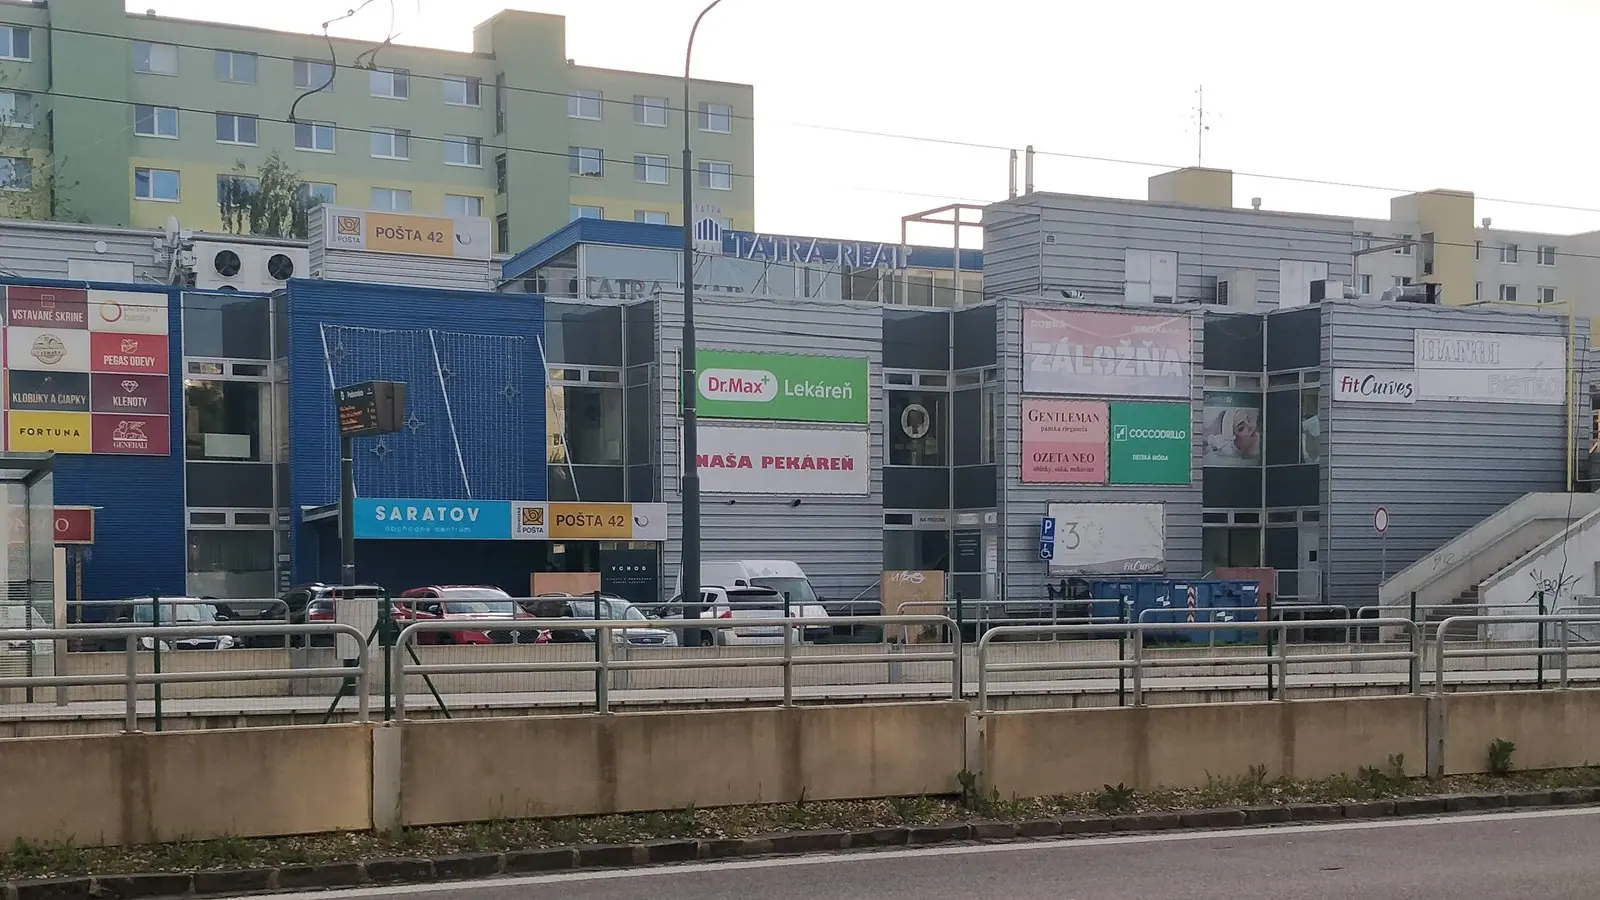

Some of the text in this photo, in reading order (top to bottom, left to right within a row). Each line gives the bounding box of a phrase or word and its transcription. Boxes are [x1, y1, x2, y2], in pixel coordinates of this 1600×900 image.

[338, 235, 360, 244] POŠTA
[376, 225, 443, 243] POŠTA 42
[731, 232, 825, 263] TATRA
[55, 311, 84, 323] SKRINE
[103, 355, 156, 367] PEGAS ODEVY
[1030, 336, 1183, 377] ZÁLOŽŇA
[784, 379, 852, 400] Lekáreň
[113, 396, 148, 407] KLENOTY
[19, 427, 80, 436] FORTUNA
[1129, 428, 1186, 439] COCCODRILLO
[113, 441, 148, 449] GENERALI
[697, 453, 854, 471] NAŠA PEKÁREŇ
[1033, 452, 1095, 463] OZETA NEO
[375, 505, 480, 522] SARATOV
[556, 511, 625, 527] POŠTA 42
[522, 526, 544, 534] POŠTA
[1044, 520, 1053, 535] P
